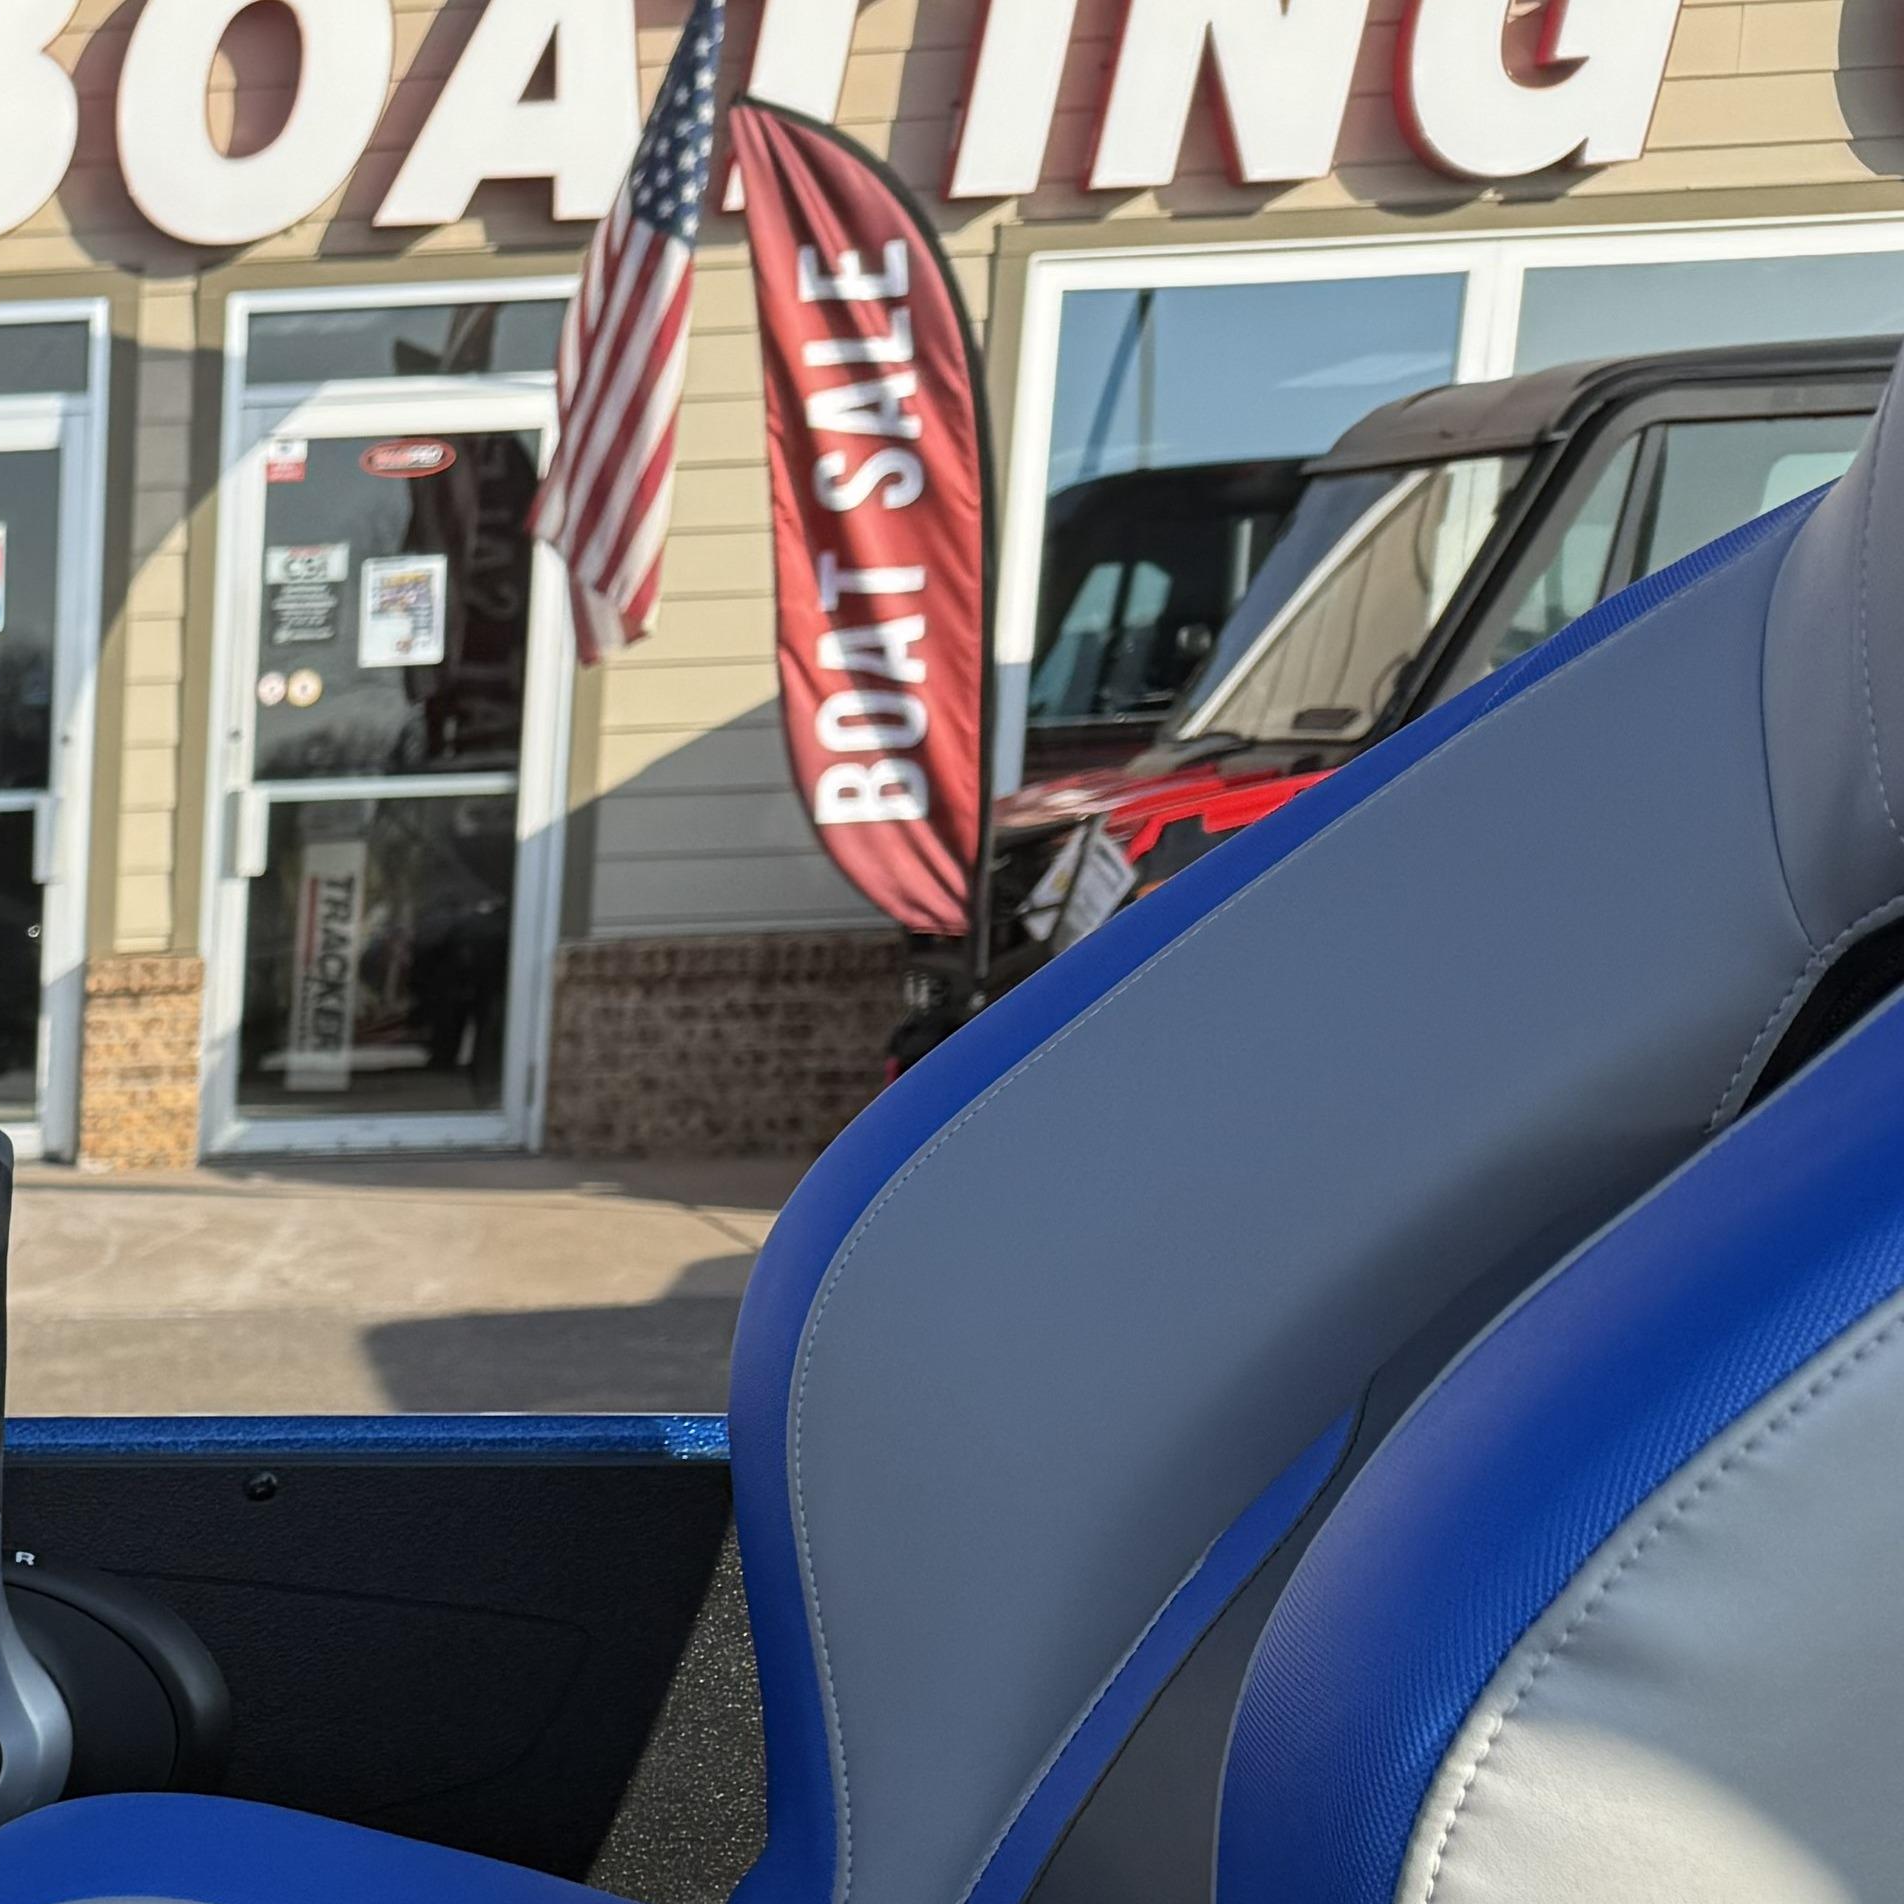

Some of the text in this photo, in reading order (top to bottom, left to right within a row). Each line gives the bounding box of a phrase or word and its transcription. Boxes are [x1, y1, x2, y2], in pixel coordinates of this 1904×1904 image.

[799, 238, 929, 826] BOAT SALE
[14, 1550, 36, 1566] R
